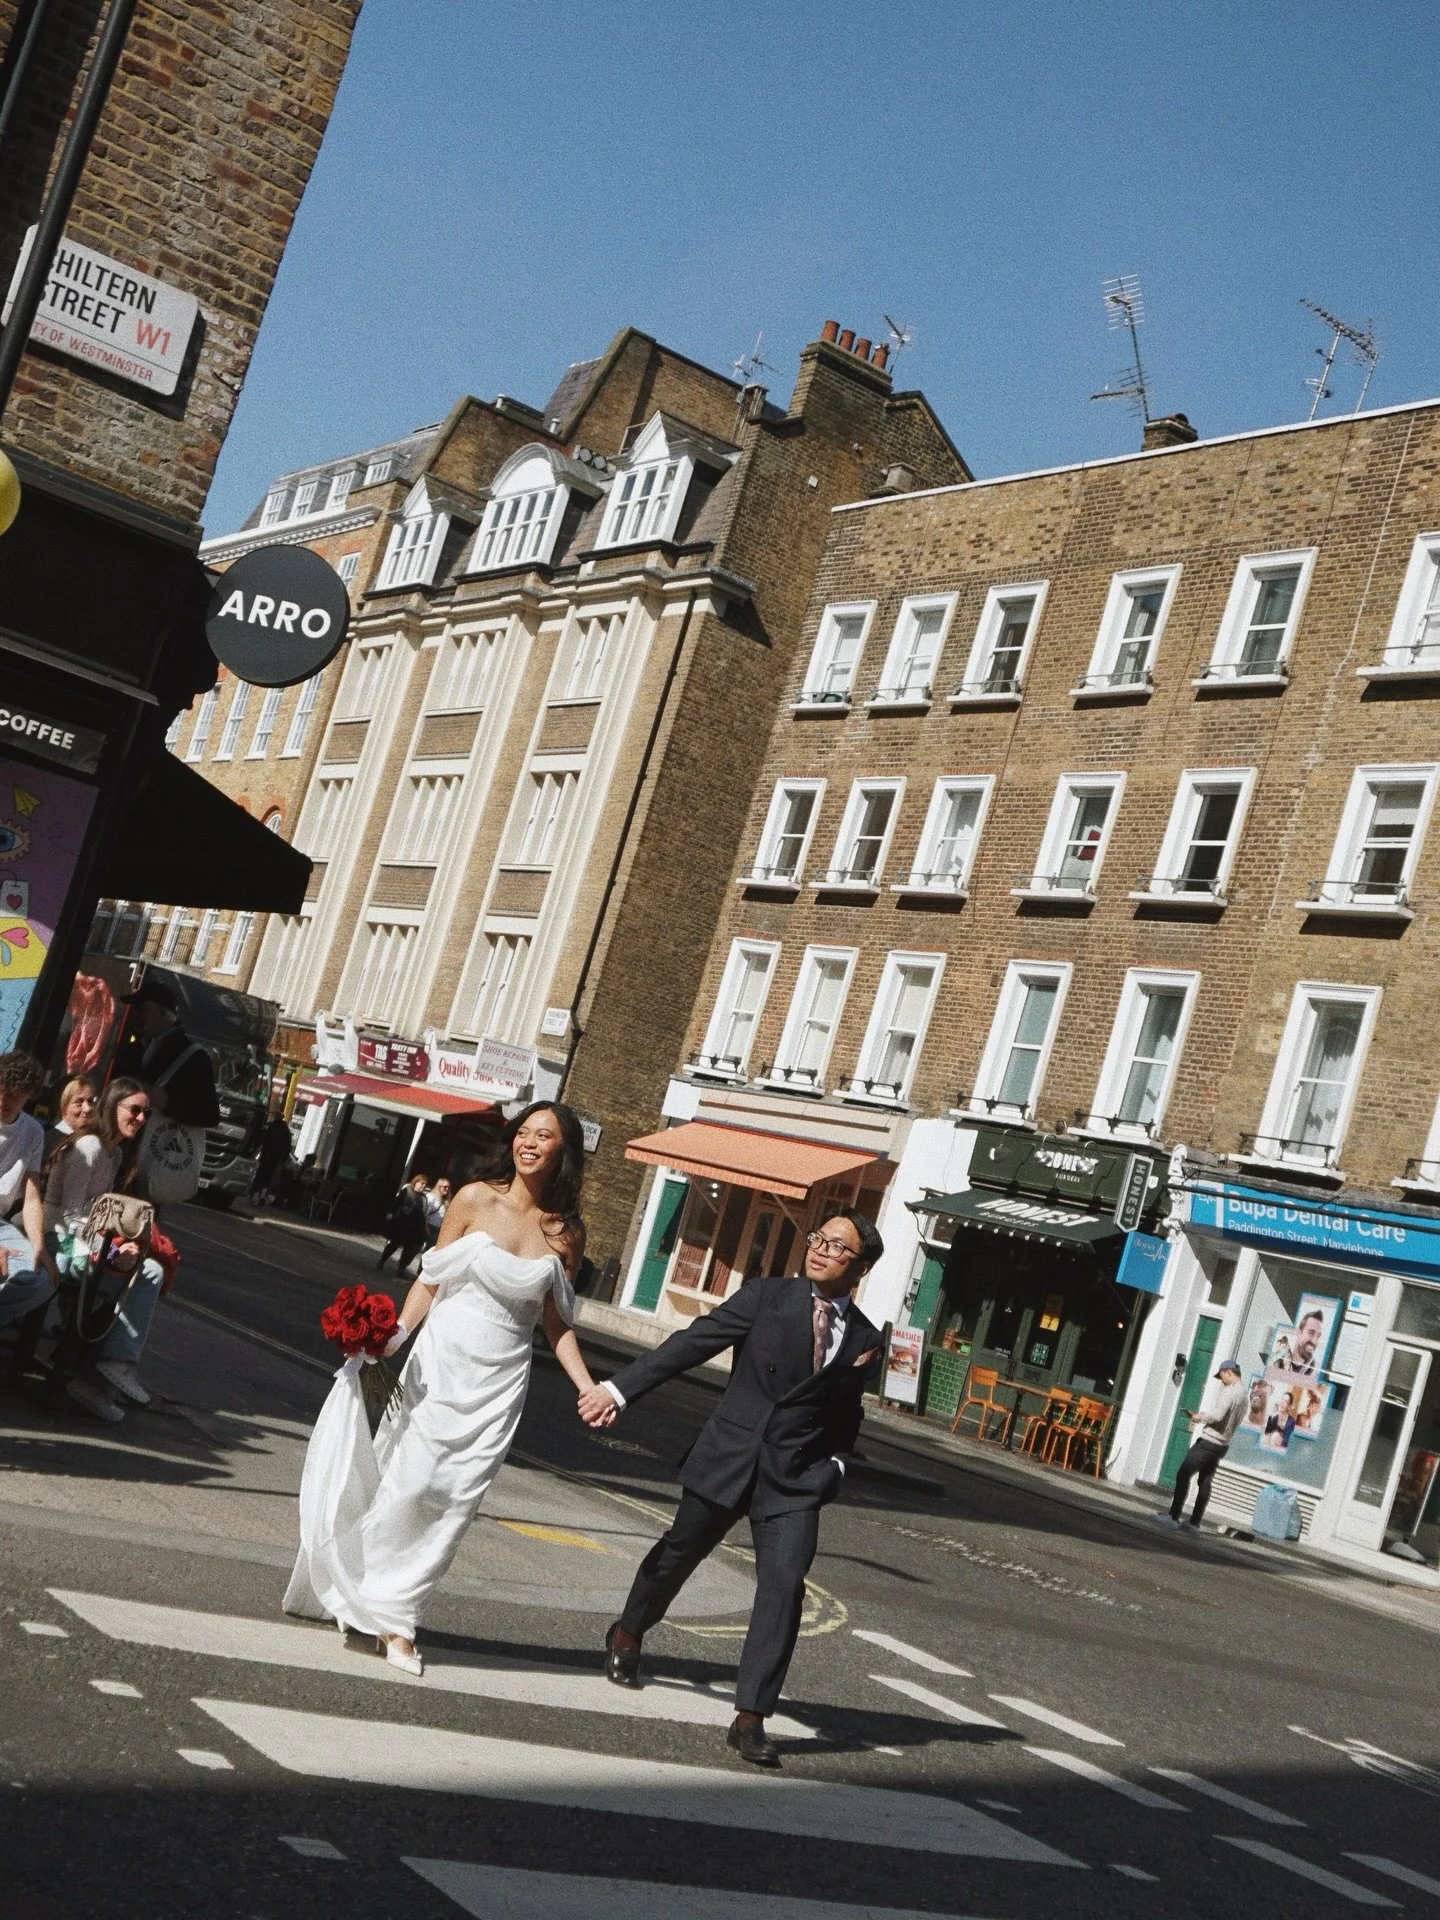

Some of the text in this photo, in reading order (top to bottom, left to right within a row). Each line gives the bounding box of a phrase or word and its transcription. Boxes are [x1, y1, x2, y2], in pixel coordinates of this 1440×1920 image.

[52, 248, 157, 314] HILTERN
[33, 321, 154, 382] TY OF WESTMINSTER
[135, 318, 173, 356] W1
[217, 589, 331, 638] ARRO
[0, 708, 76, 750] COFFEE
[439, 1057, 470, 1085] Quality
[481, 1062, 525, 1079] KEY CUTTING
[483, 1044, 530, 1063] SHOE REPAIRS
[975, 1198, 1100, 1227] HONEST
[1124, 1163, 1147, 1225] HONEST
[1228, 1190, 1407, 1243] Bupa Dental Care
[1228, 1219, 1284, 1240] Paddington
